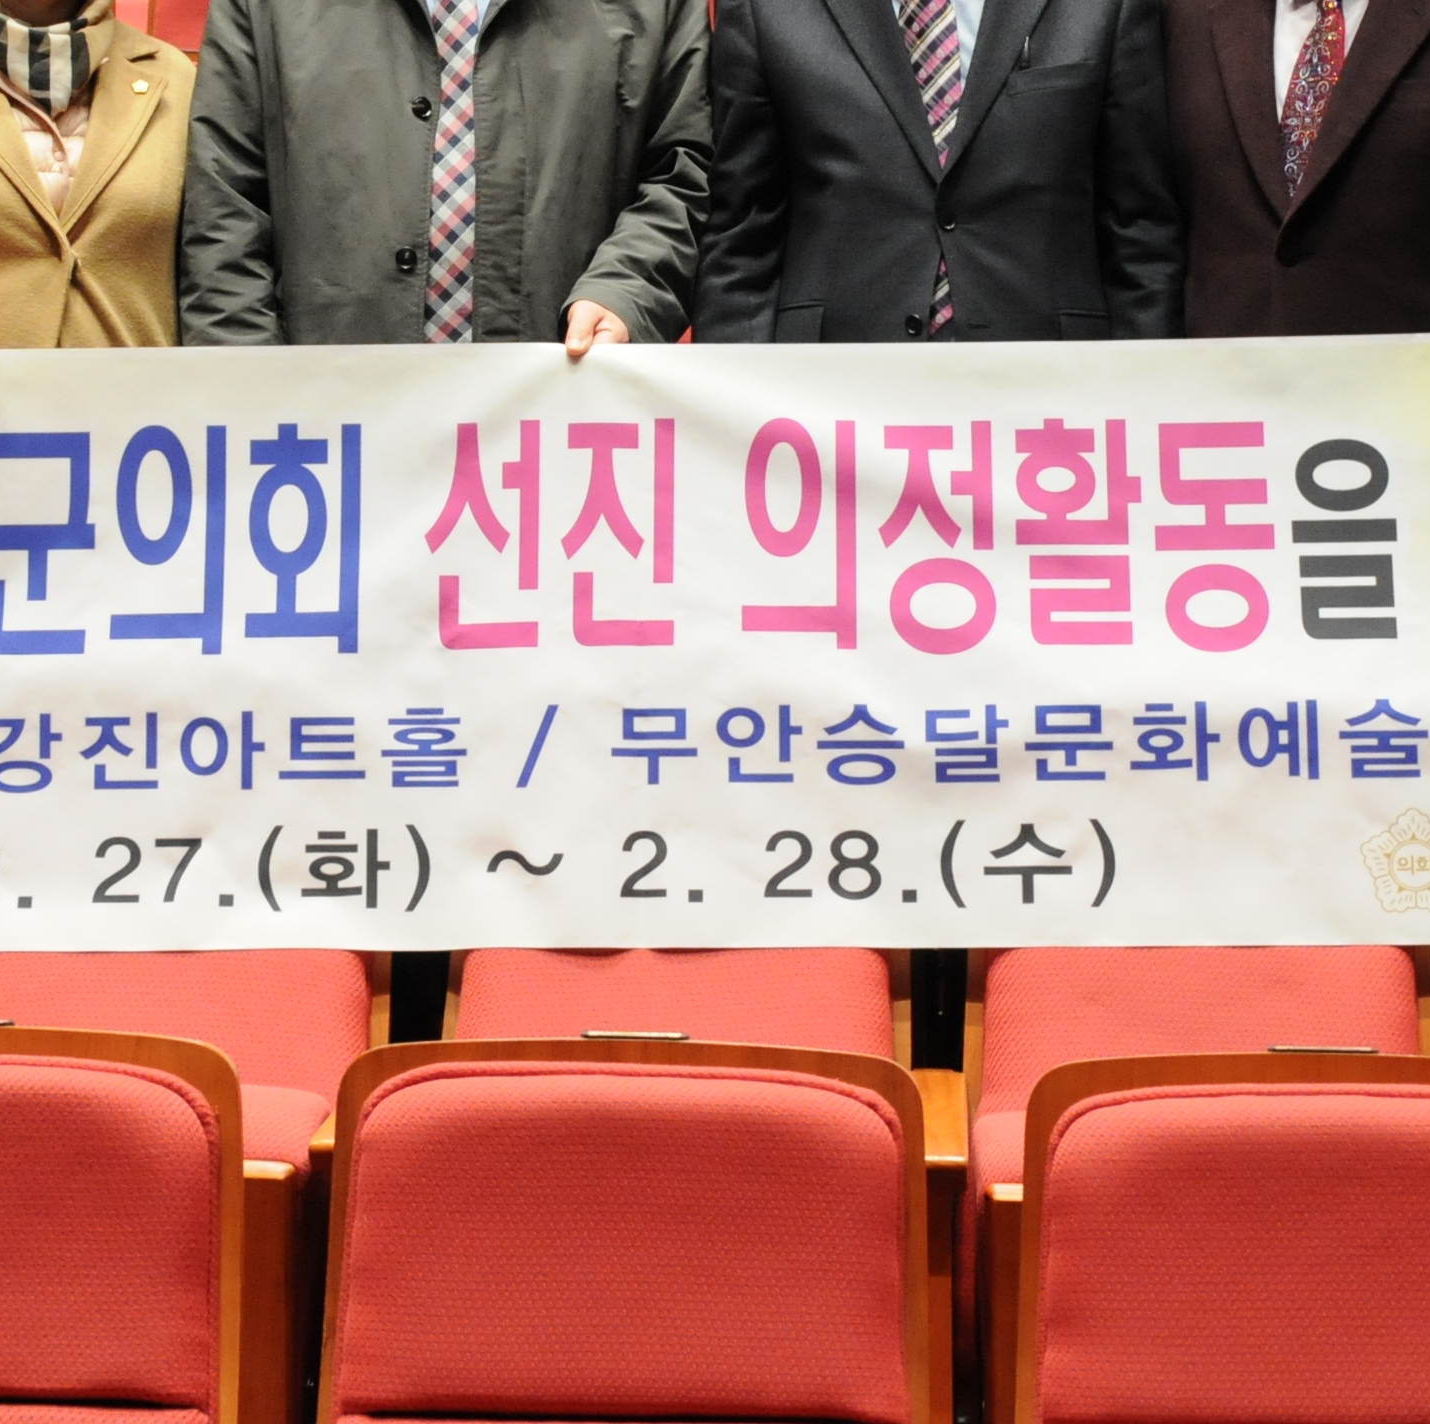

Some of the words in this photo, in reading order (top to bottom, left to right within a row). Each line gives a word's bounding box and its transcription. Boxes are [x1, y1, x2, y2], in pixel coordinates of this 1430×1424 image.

[424, 417, 677, 651] 선진
[741, 416, 1399, 655] 의정활동을
[515, 703, 561, 789] /
[91, 824, 433, 912] 27.(화)
[619, 831, 704, 903] 2.
[763, 818, 1118, 908] 28.(수)
